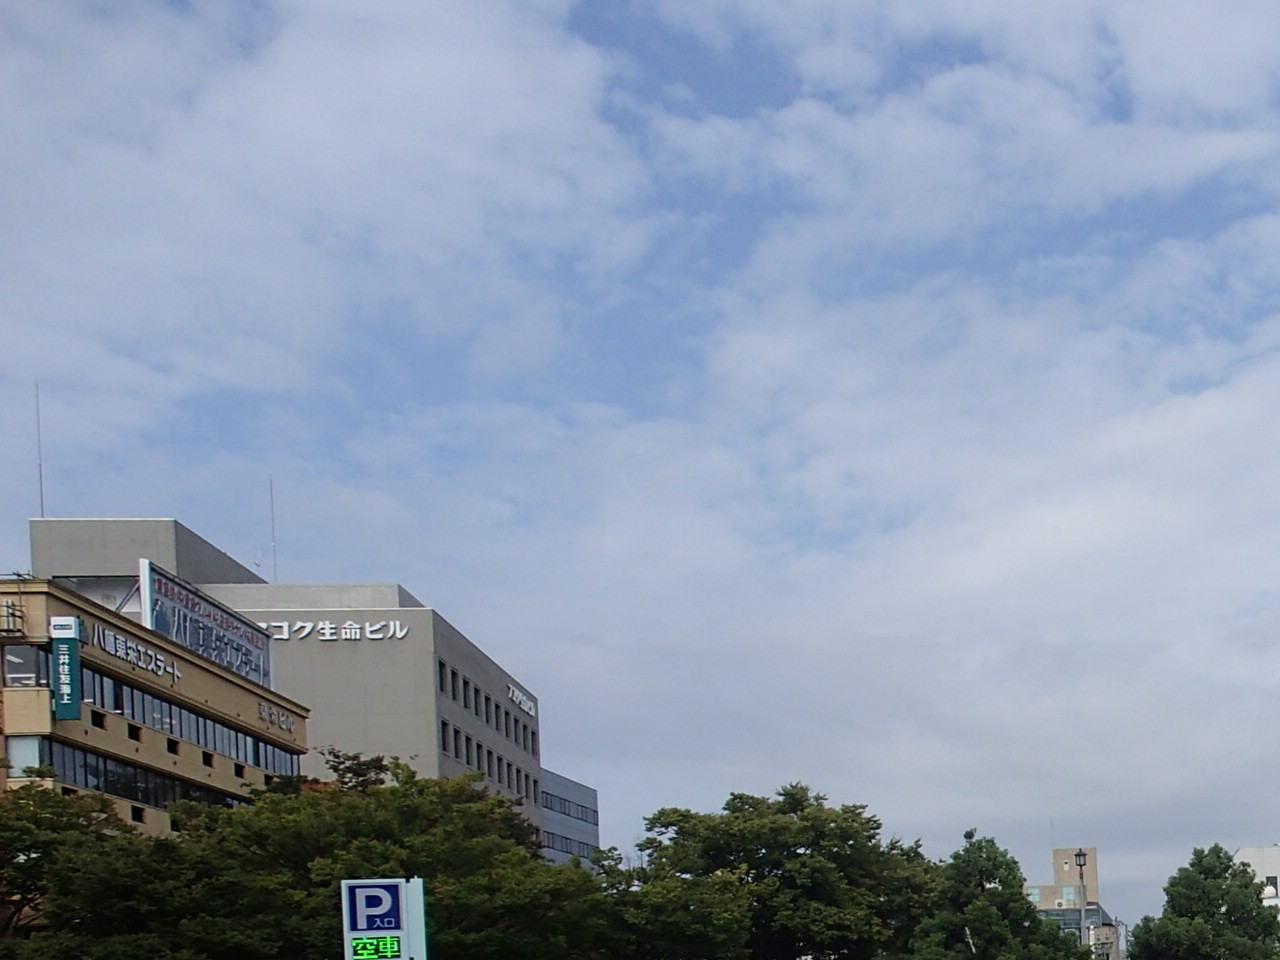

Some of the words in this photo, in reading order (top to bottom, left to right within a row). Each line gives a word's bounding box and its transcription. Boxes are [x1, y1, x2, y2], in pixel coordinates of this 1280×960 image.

[256, 620, 409, 641] コク生命ビル
[58, 644, 72, 704] 三井住友海上
[355, 888, 392, 930] P
[373, 918, 395, 929] 入口
[352, 936, 401, 960] 空車
